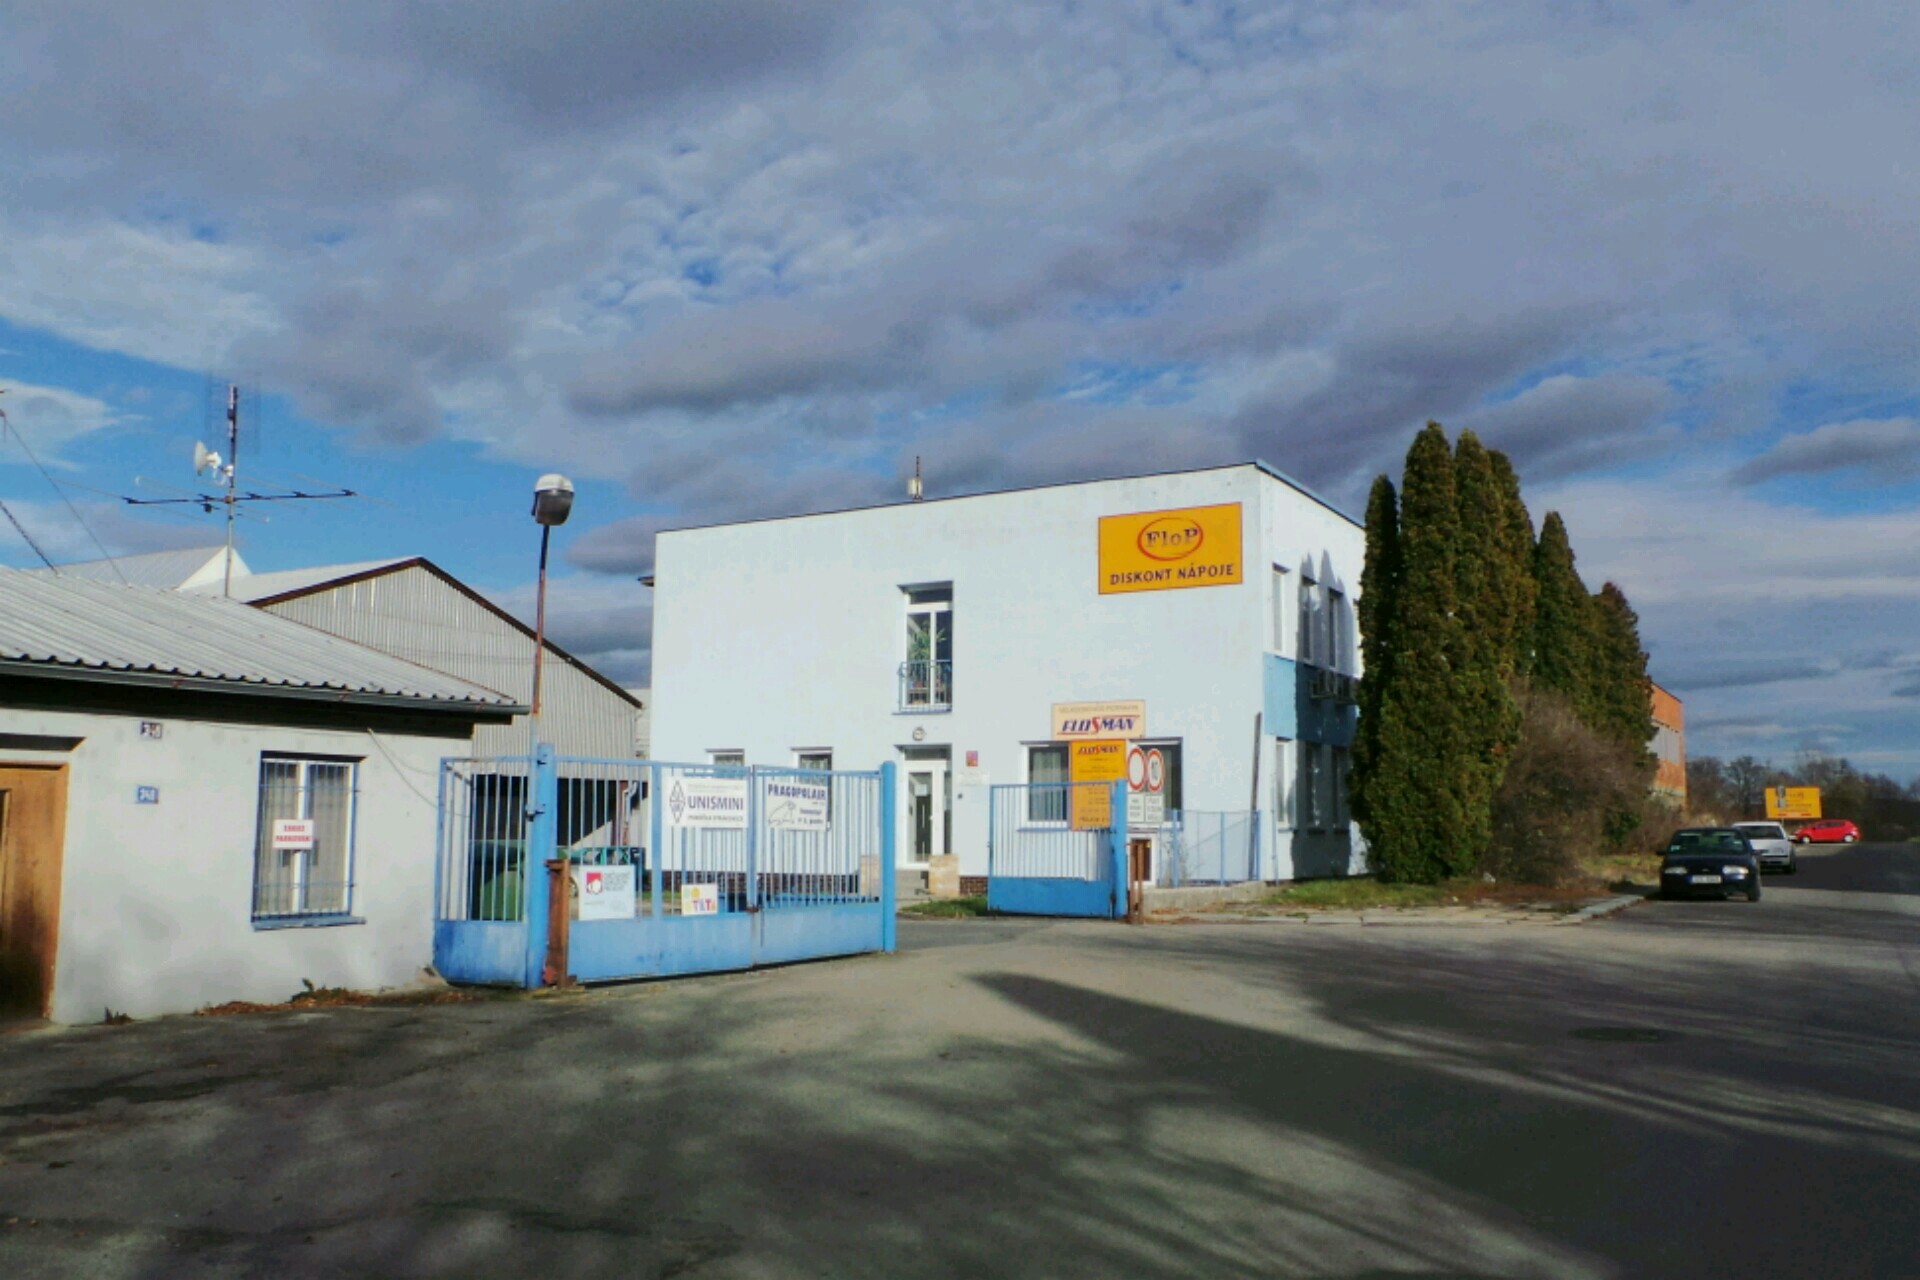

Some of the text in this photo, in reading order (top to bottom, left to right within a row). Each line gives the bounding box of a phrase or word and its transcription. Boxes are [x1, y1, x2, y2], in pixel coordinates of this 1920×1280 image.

[1110, 563, 1233, 585] DISKONT NÁPOJE
[687, 795, 743, 811] UNISMINI
